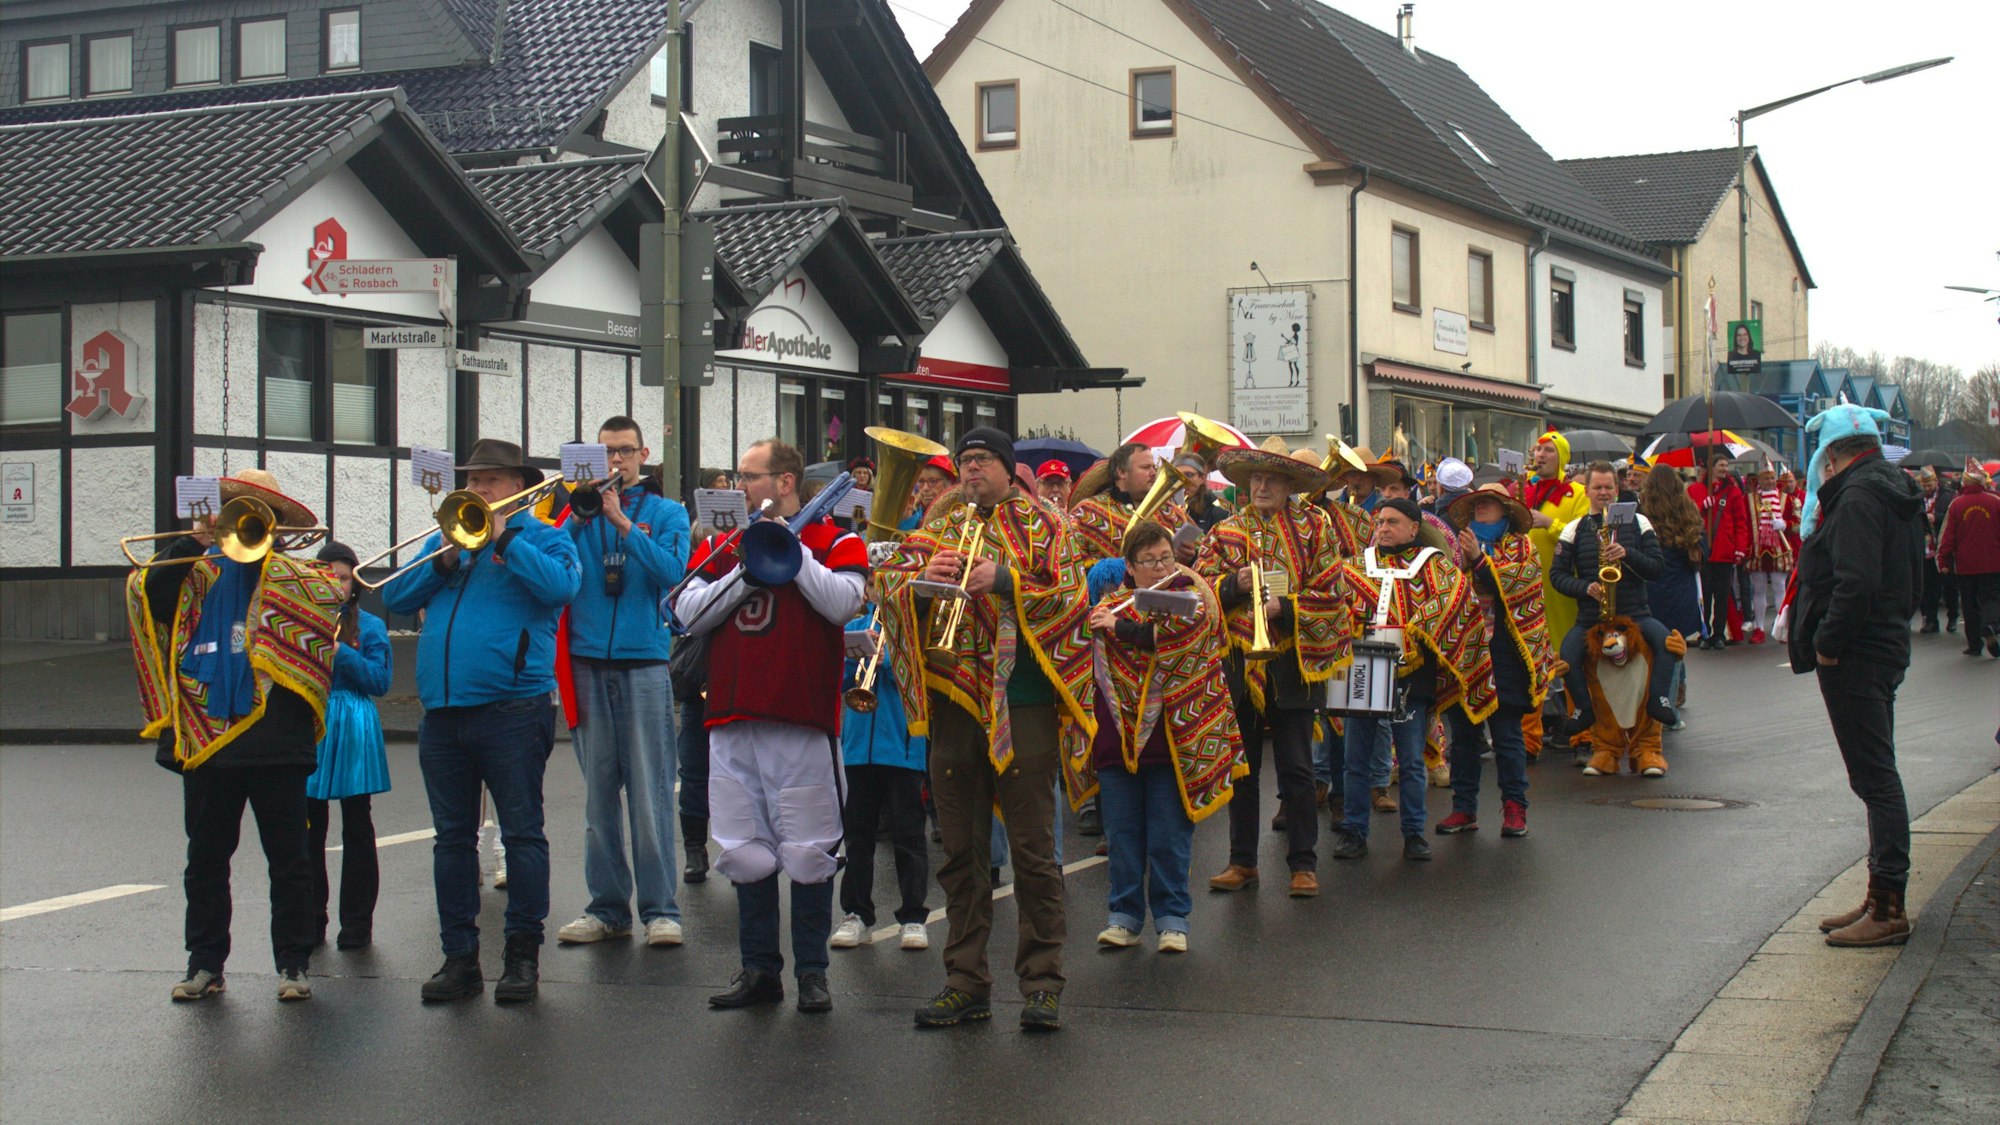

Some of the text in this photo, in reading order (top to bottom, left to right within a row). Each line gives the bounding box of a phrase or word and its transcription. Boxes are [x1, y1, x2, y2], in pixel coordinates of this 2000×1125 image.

[339, 264, 393, 275] Schladern
[353, 278, 398, 288] Rosbach
[1268, 312, 1278, 325] by
[607, 319, 638, 338] Besser
[371, 330, 437, 344] Marktstraße
[742, 325, 832, 361] dlerApotheke
[462, 353, 508, 371] Rathausstraße
[1240, 414, 1258, 428] Hier
[1262, 418, 1271, 426] im
[1353, 664, 1366, 700] THOMANN
